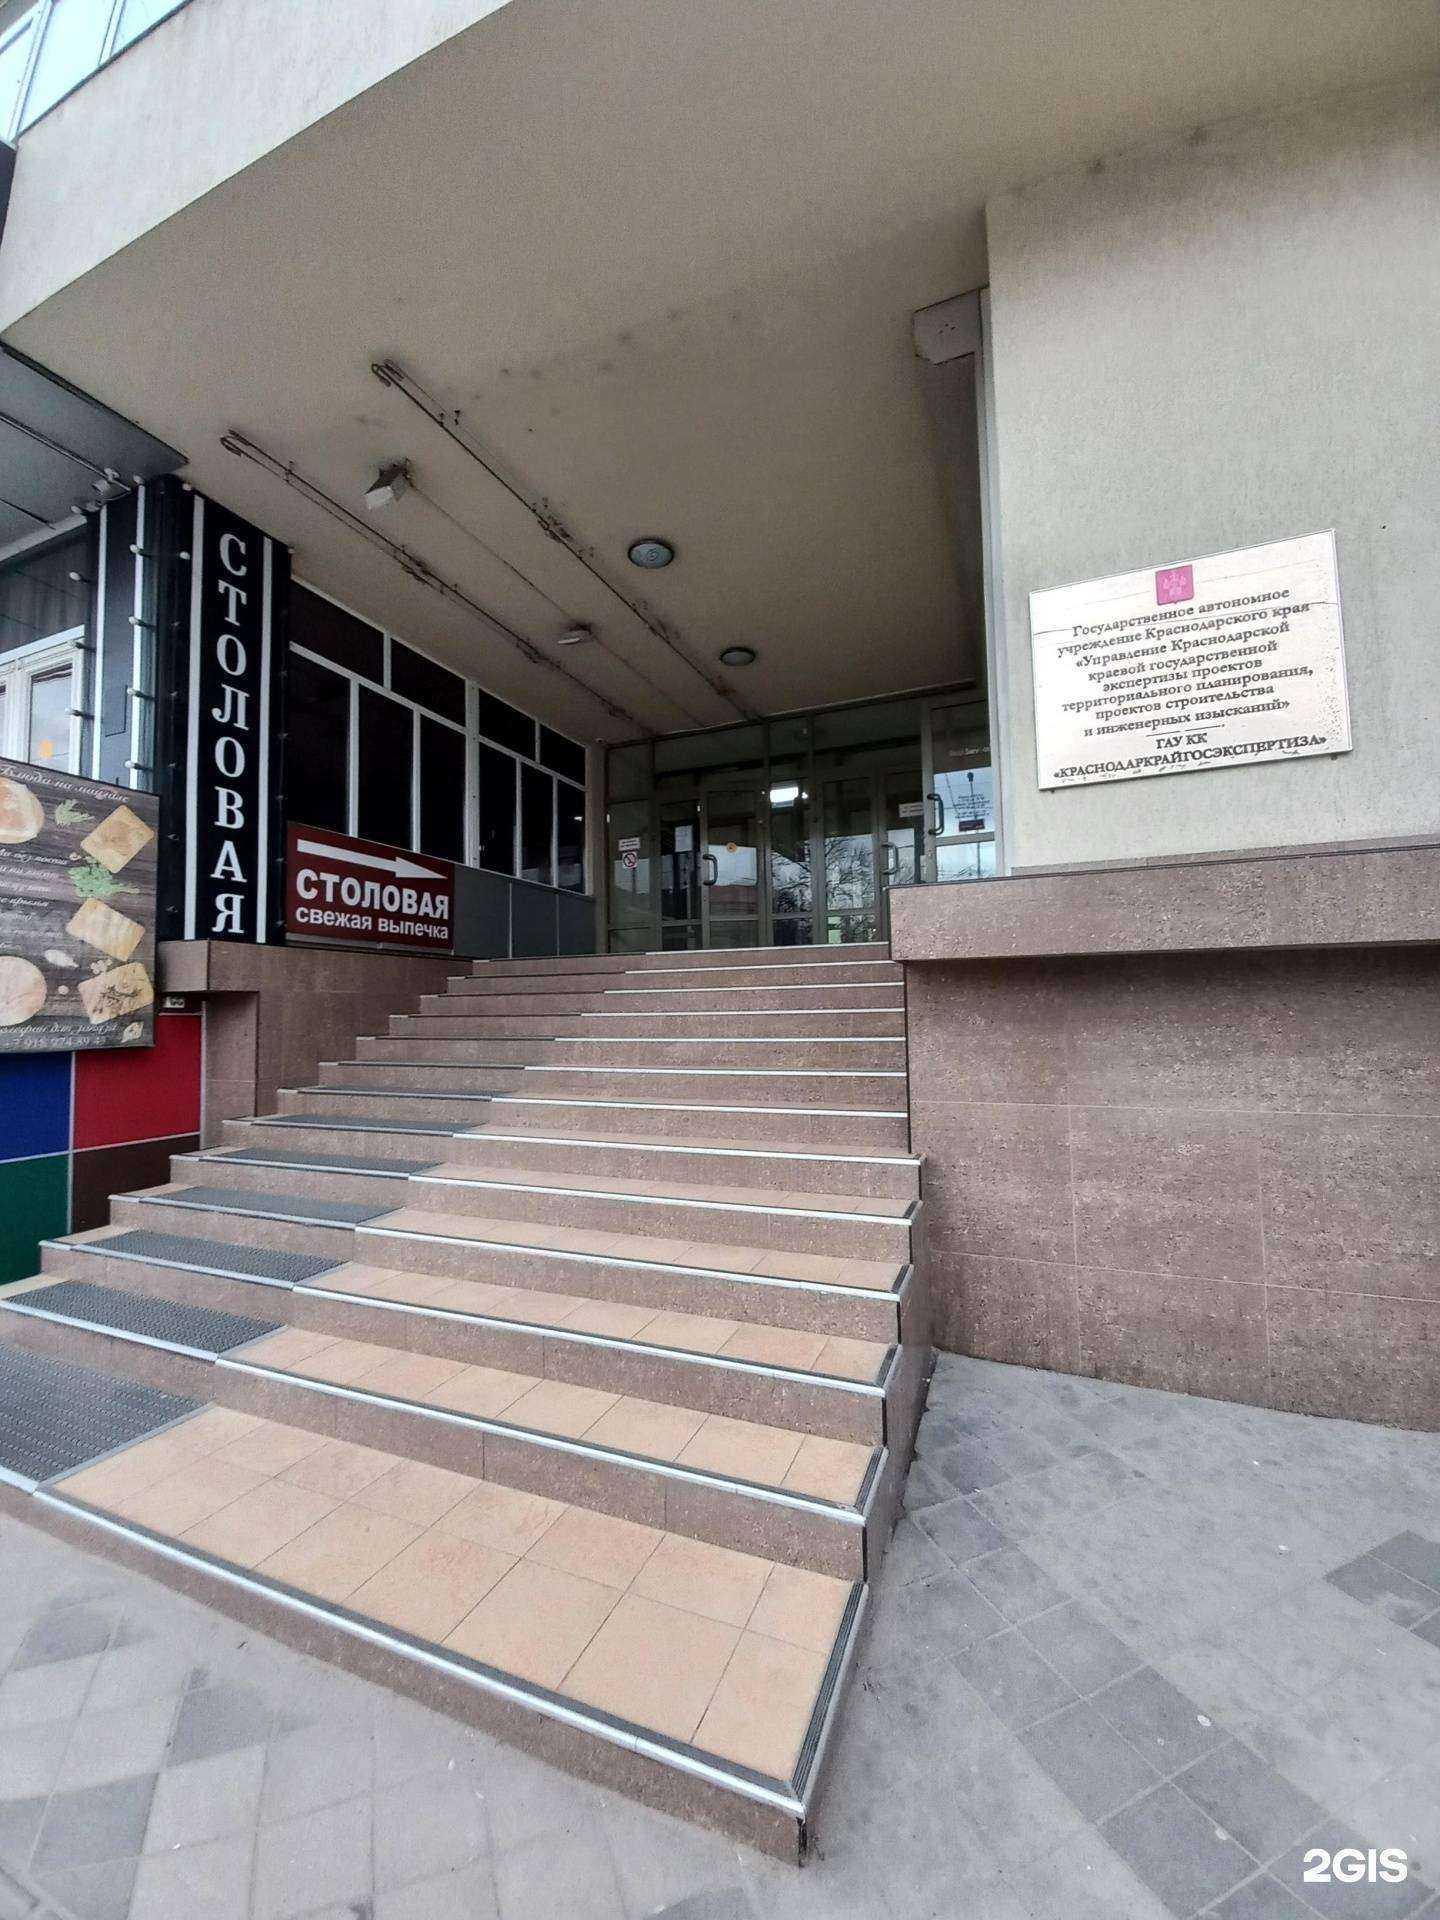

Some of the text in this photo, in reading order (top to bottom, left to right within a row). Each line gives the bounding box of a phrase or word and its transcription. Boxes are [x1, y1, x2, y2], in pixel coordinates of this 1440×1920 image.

[1057, 603, 1310, 658] учреждение Краснодарского края
[1072, 589, 1290, 637] Государственное автономное
[1076, 621, 1290, 668] «Управление Краснодарской
[1088, 640, 1278, 683] краевой государственной
[1062, 666, 1313, 712] территориального планирования,
[1103, 659, 1263, 692] экспертизы проектов
[1084, 698, 1290, 737] и инженерных изысканий»
[1096, 685, 1274, 721] проектов строительства
[211, 533, 250, 934] СТОЛОВАЯ
[1156, 732, 1208, 749] ГАУ КК
[1053, 734, 1327, 778] «КРАСНОДАРКРАЙГОСЭКСПЕРТИЗА»
[296, 868, 449, 920] СТОЛОВАЯ
[296, 906, 449, 939] свежая выпечка
